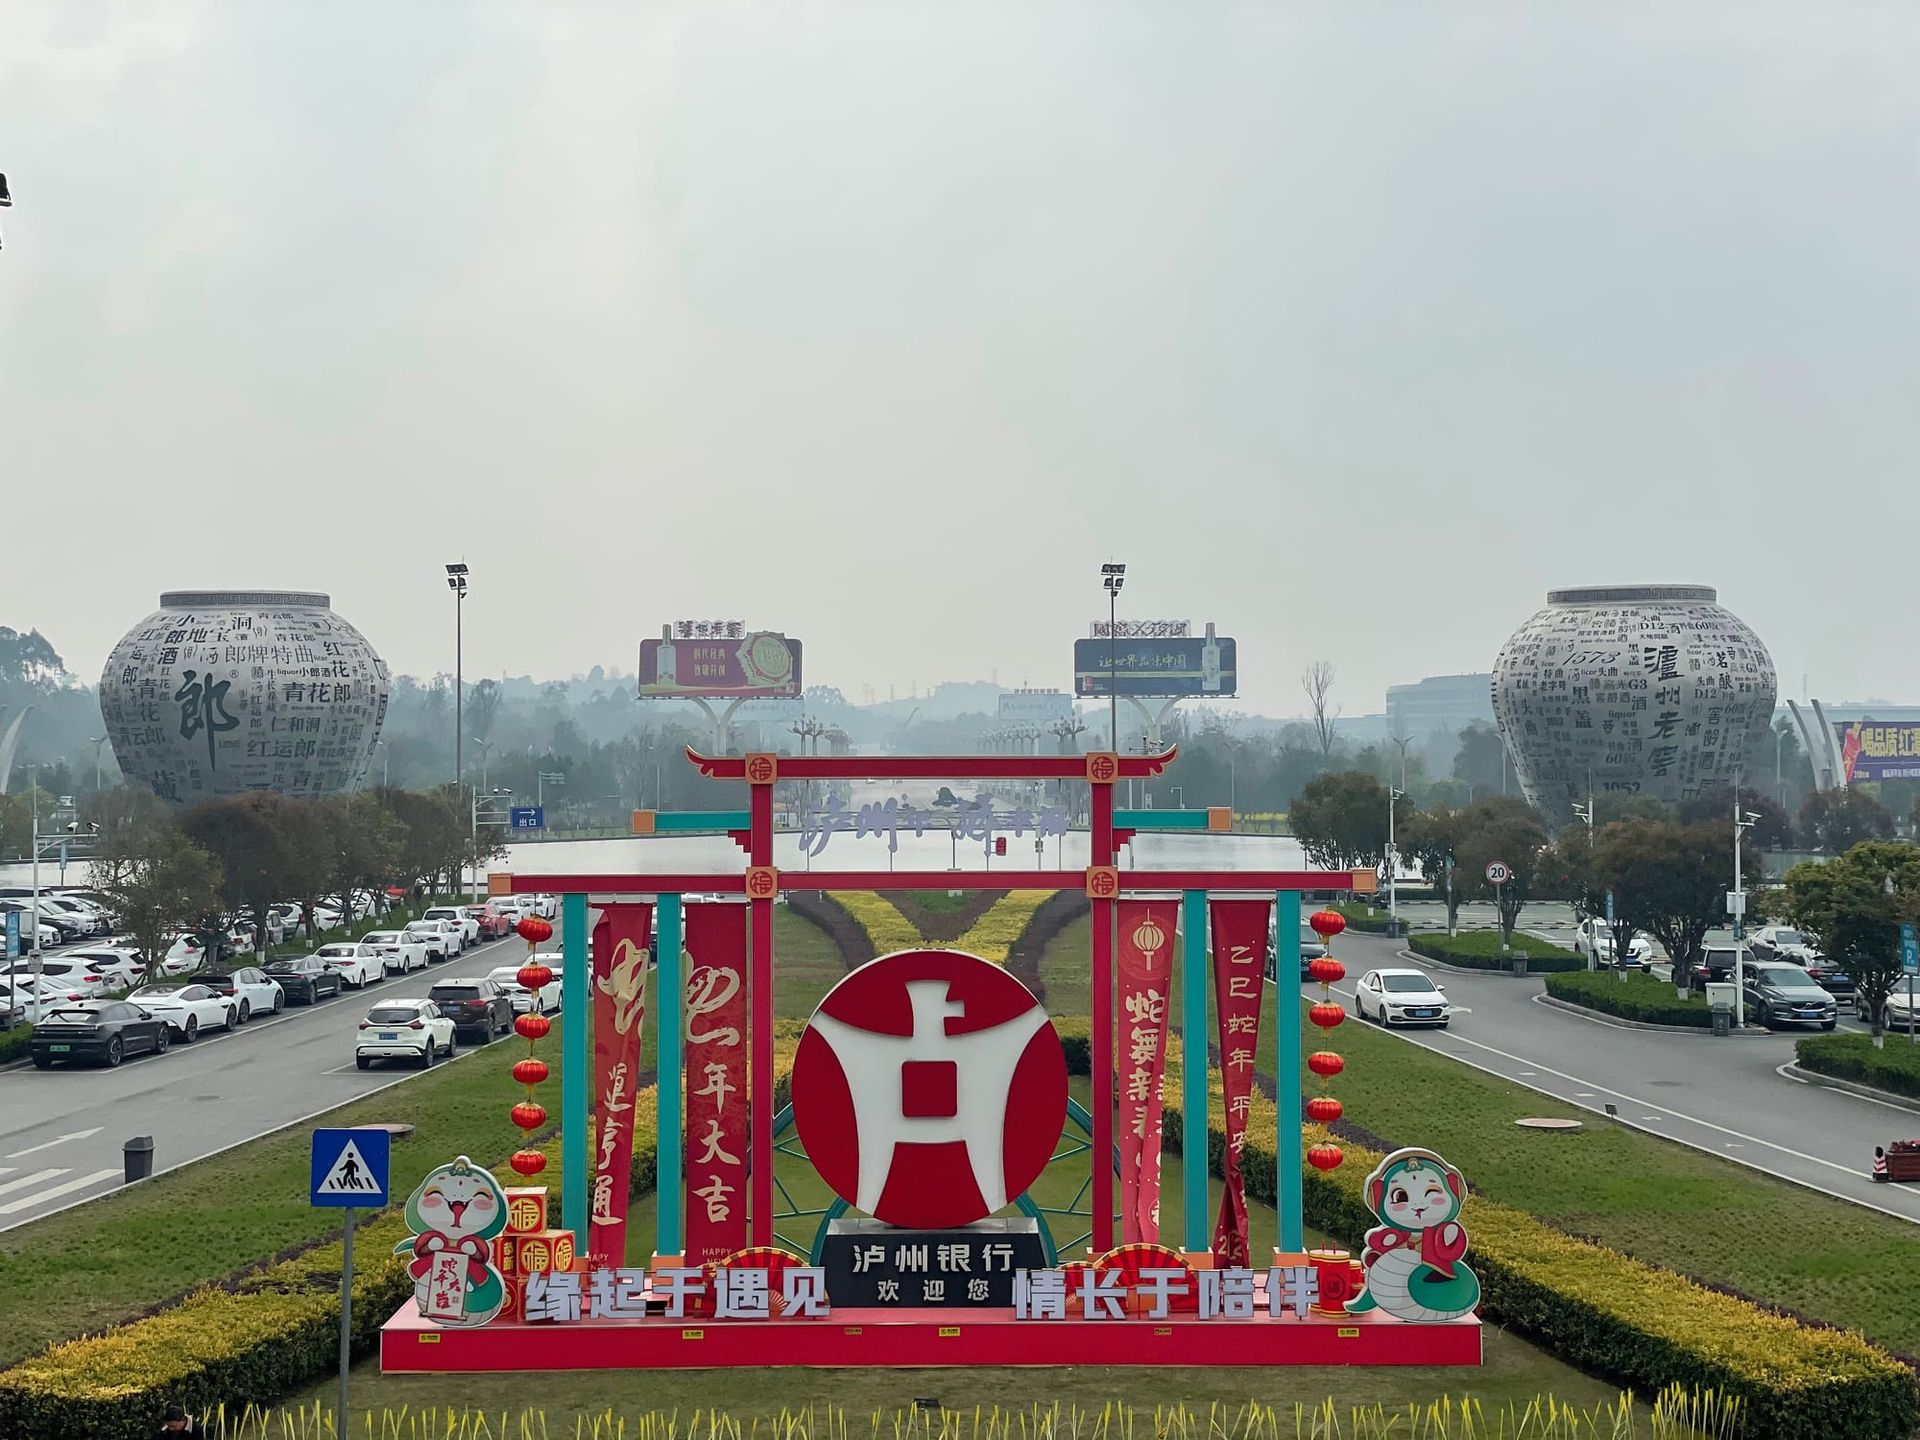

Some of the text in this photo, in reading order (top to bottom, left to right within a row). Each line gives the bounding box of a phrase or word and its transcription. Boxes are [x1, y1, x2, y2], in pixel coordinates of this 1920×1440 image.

[225, 644, 315, 665] 郎牌特曲
[1562, 651, 1621, 666] 1573
[282, 682, 351, 704] 青花郎
[175, 670, 240, 772] 郎
[247, 738, 317, 759] 红运郎
[519, 817, 537, 827] 出口
[1490, 867, 1505, 878] 20
[702, 1247, 732, 1256] HAPPY
[852, 1243, 1015, 1273] 泸州银行
[526, 1267, 830, 1321] 缘起于遇见
[877, 1278, 990, 1302] 欢迎您
[1012, 1266, 1320, 1320] 情长于陪伴
